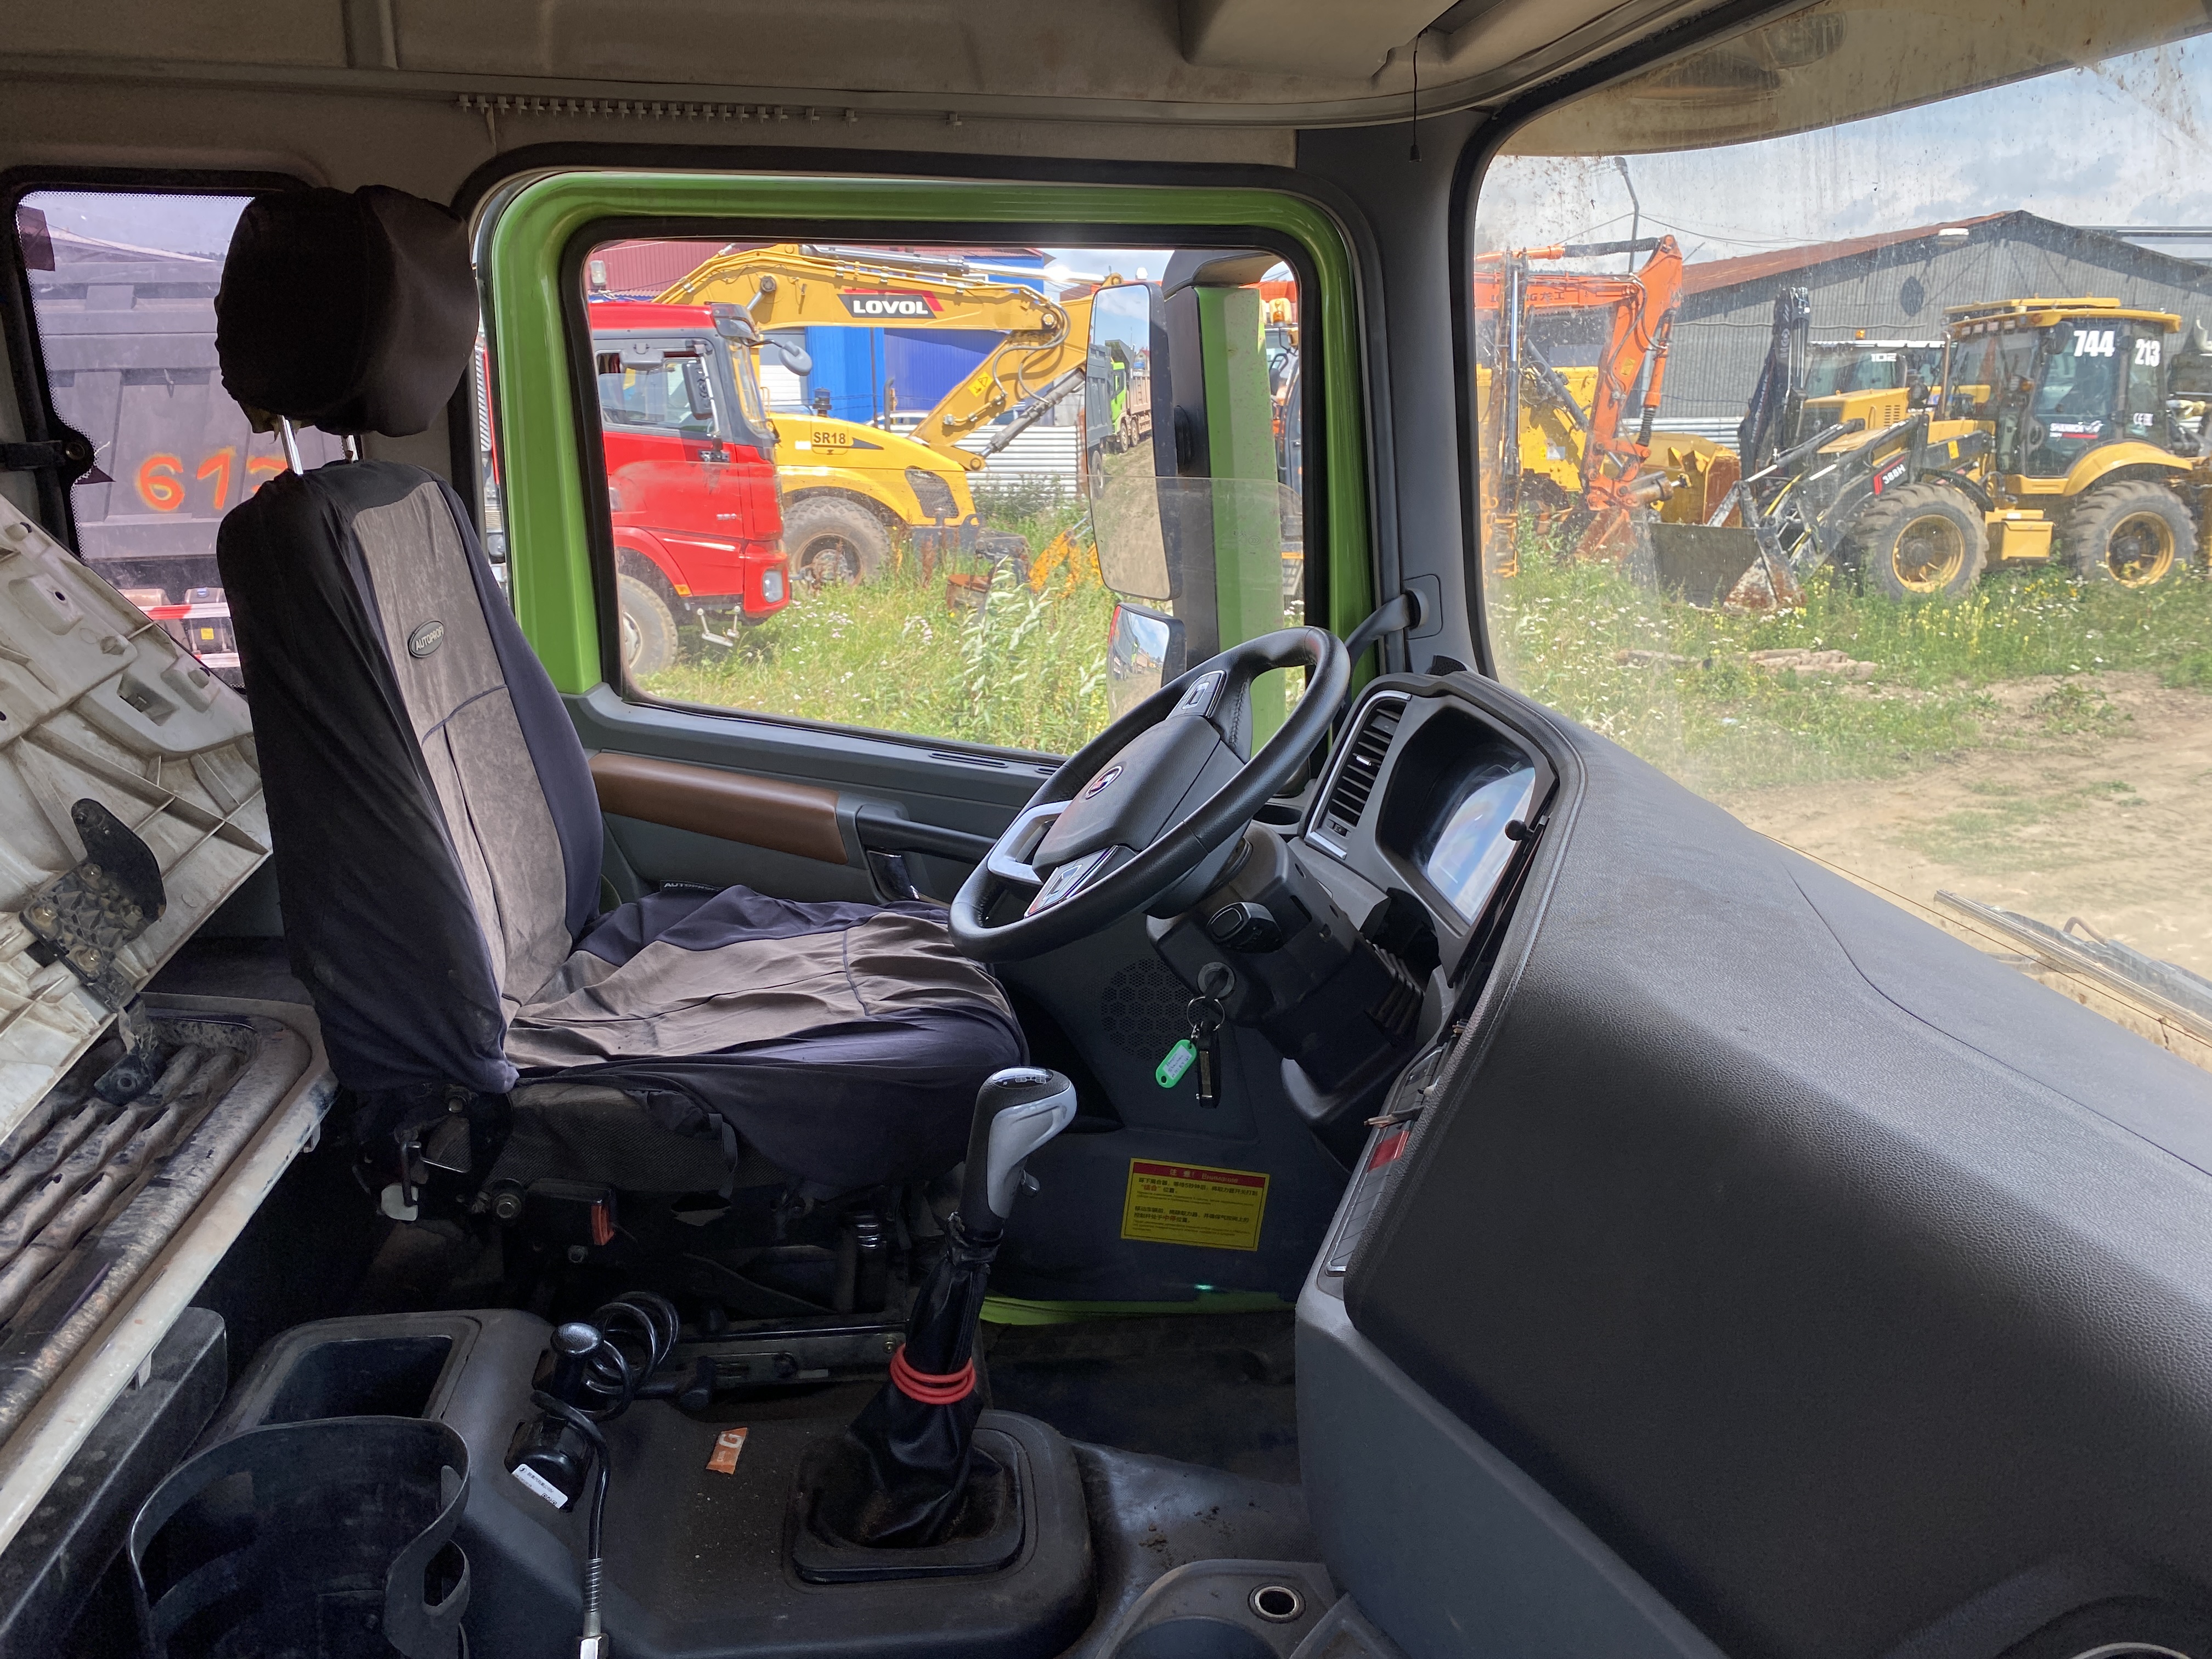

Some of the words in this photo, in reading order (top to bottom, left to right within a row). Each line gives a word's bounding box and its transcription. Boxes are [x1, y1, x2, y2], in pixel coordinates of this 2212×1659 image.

[853, 300, 928, 315] LOVOL
[2073, 330, 2115, 357] 744
[2135, 338, 2161, 368] 213
[1871, 352, 1897, 362] 102
[813, 431, 847, 445] SR18
[1882, 464, 1906, 484] 388H
[415, 625, 444, 651] AUTOPROFI
